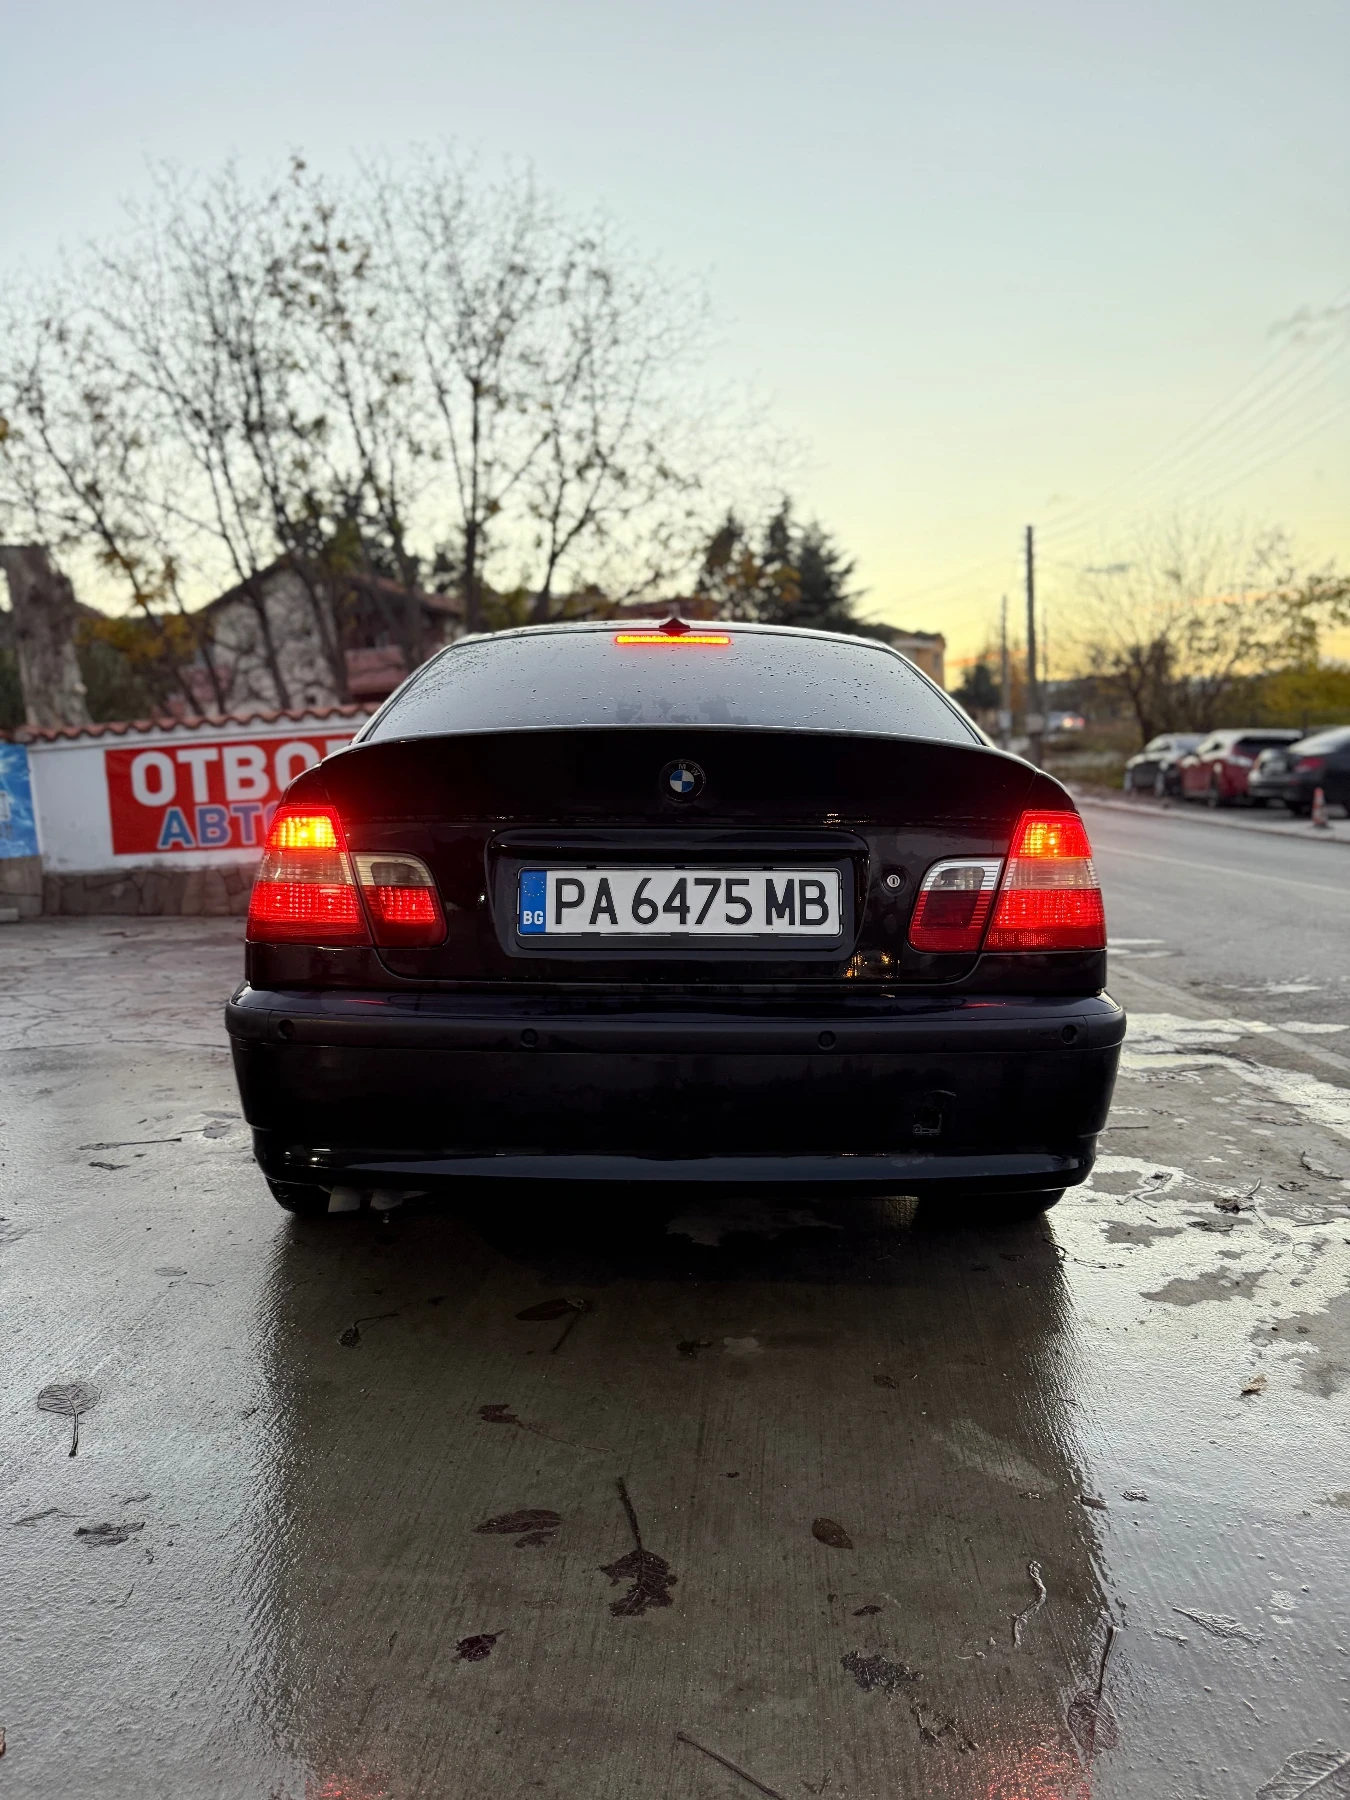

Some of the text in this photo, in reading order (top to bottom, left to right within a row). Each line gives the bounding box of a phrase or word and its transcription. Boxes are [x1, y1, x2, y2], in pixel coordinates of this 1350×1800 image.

[130, 739, 353, 807] ОТВО
[522, 910, 544, 925] BG
[554, 877, 830, 926] PA 6475 MB
